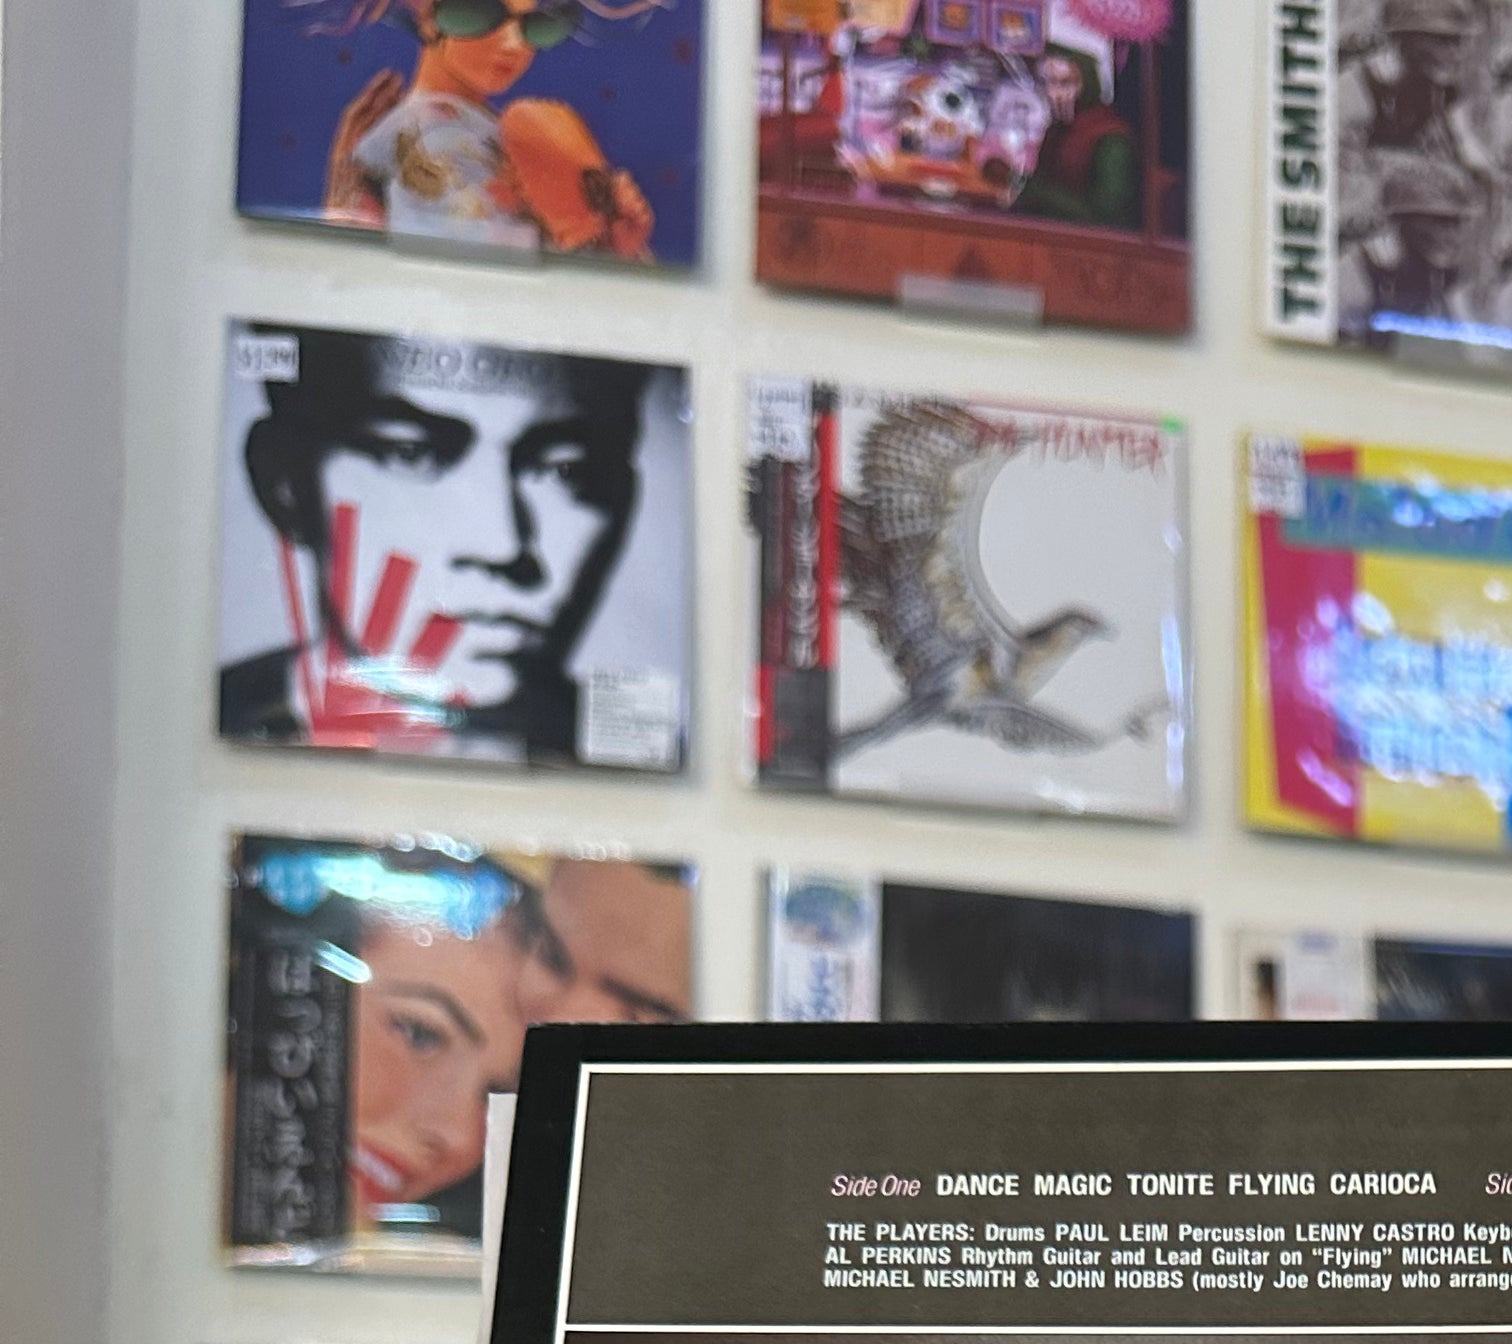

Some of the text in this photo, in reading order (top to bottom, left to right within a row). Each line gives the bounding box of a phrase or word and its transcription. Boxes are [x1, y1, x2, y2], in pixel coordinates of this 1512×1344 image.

[830, 1172, 1437, 1196] Side One DANCE MAGIC TONITE FLYING CARIOCA
[826, 1222, 866, 1241] THE
[875, 1223, 975, 1241] PLAYERS:
[985, 1224, 1046, 1242] Drums
[1055, 1224, 1110, 1242] PAUL
[1119, 1224, 1169, 1242] LEIM
[1178, 1224, 1286, 1242] Percussion
[1295, 1224, 1364, 1242] LENNY
[1372, 1223, 1455, 1242] CASTRO
[823, 1269, 915, 1288] MICHAEL
[923, 1270, 1016, 1289] NESMITH
[1024, 1271, 1040, 1289] &
[1049, 1271, 1106, 1289] JOHN
[1114, 1271, 1184, 1289] HOBBS
[1192, 1271, 1264, 1292] (mostly
[1273, 1271, 1309, 1289] Joe
[1317, 1270, 1393, 1291] Chemay
[1401, 1270, 1441, 1288] who
